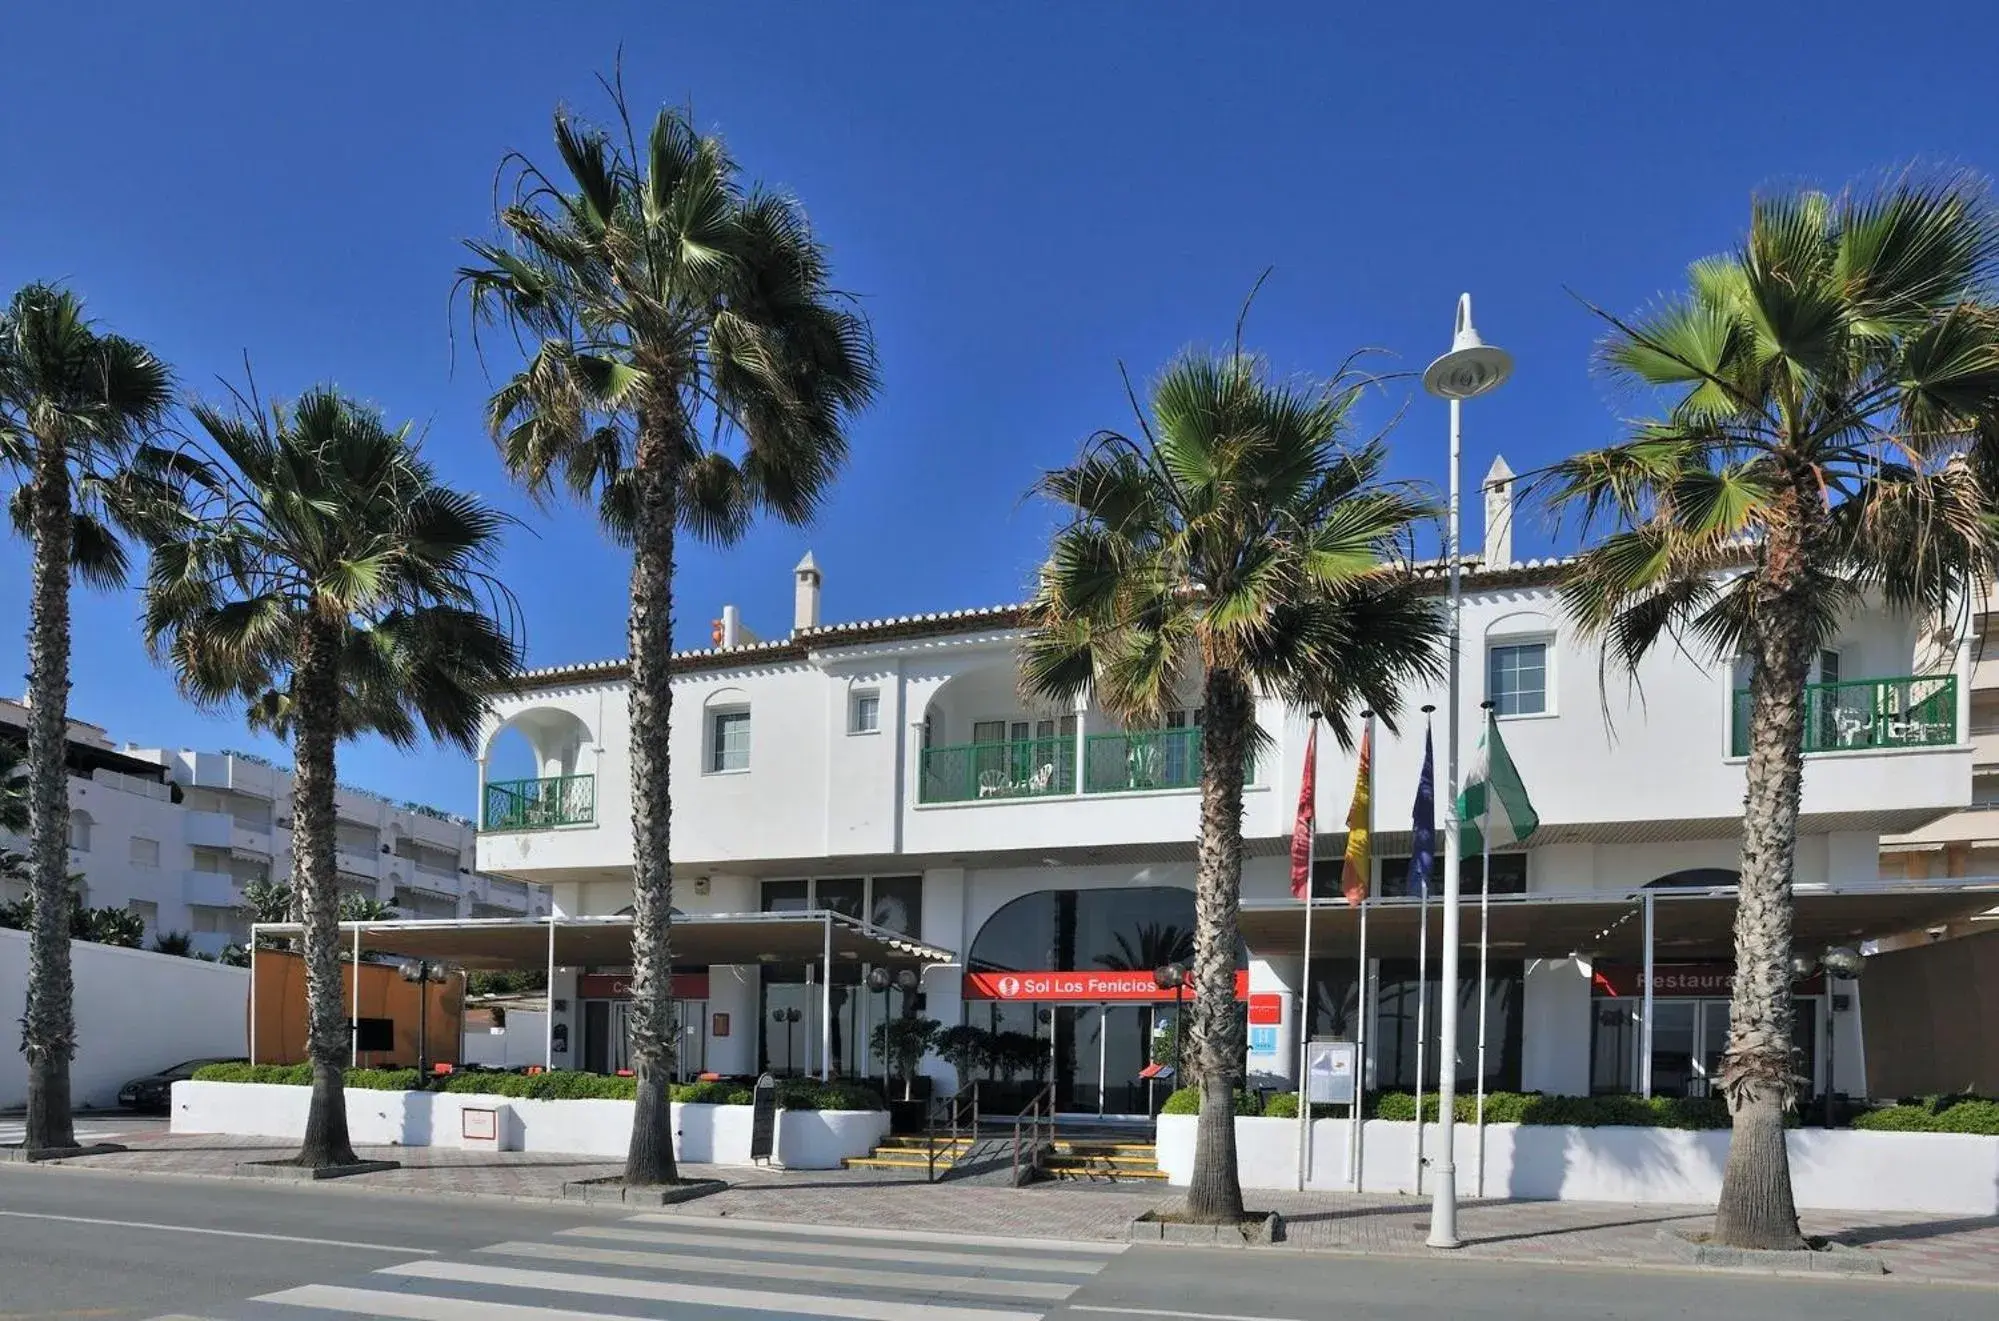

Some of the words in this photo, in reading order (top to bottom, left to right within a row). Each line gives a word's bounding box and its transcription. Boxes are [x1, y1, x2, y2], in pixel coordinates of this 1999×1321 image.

[1024, 979, 1049, 993] Sol
[1055, 979, 1083, 993] Los
[1088, 978, 1156, 993] Fenicios
[1636, 973, 1733, 988] Restaura
